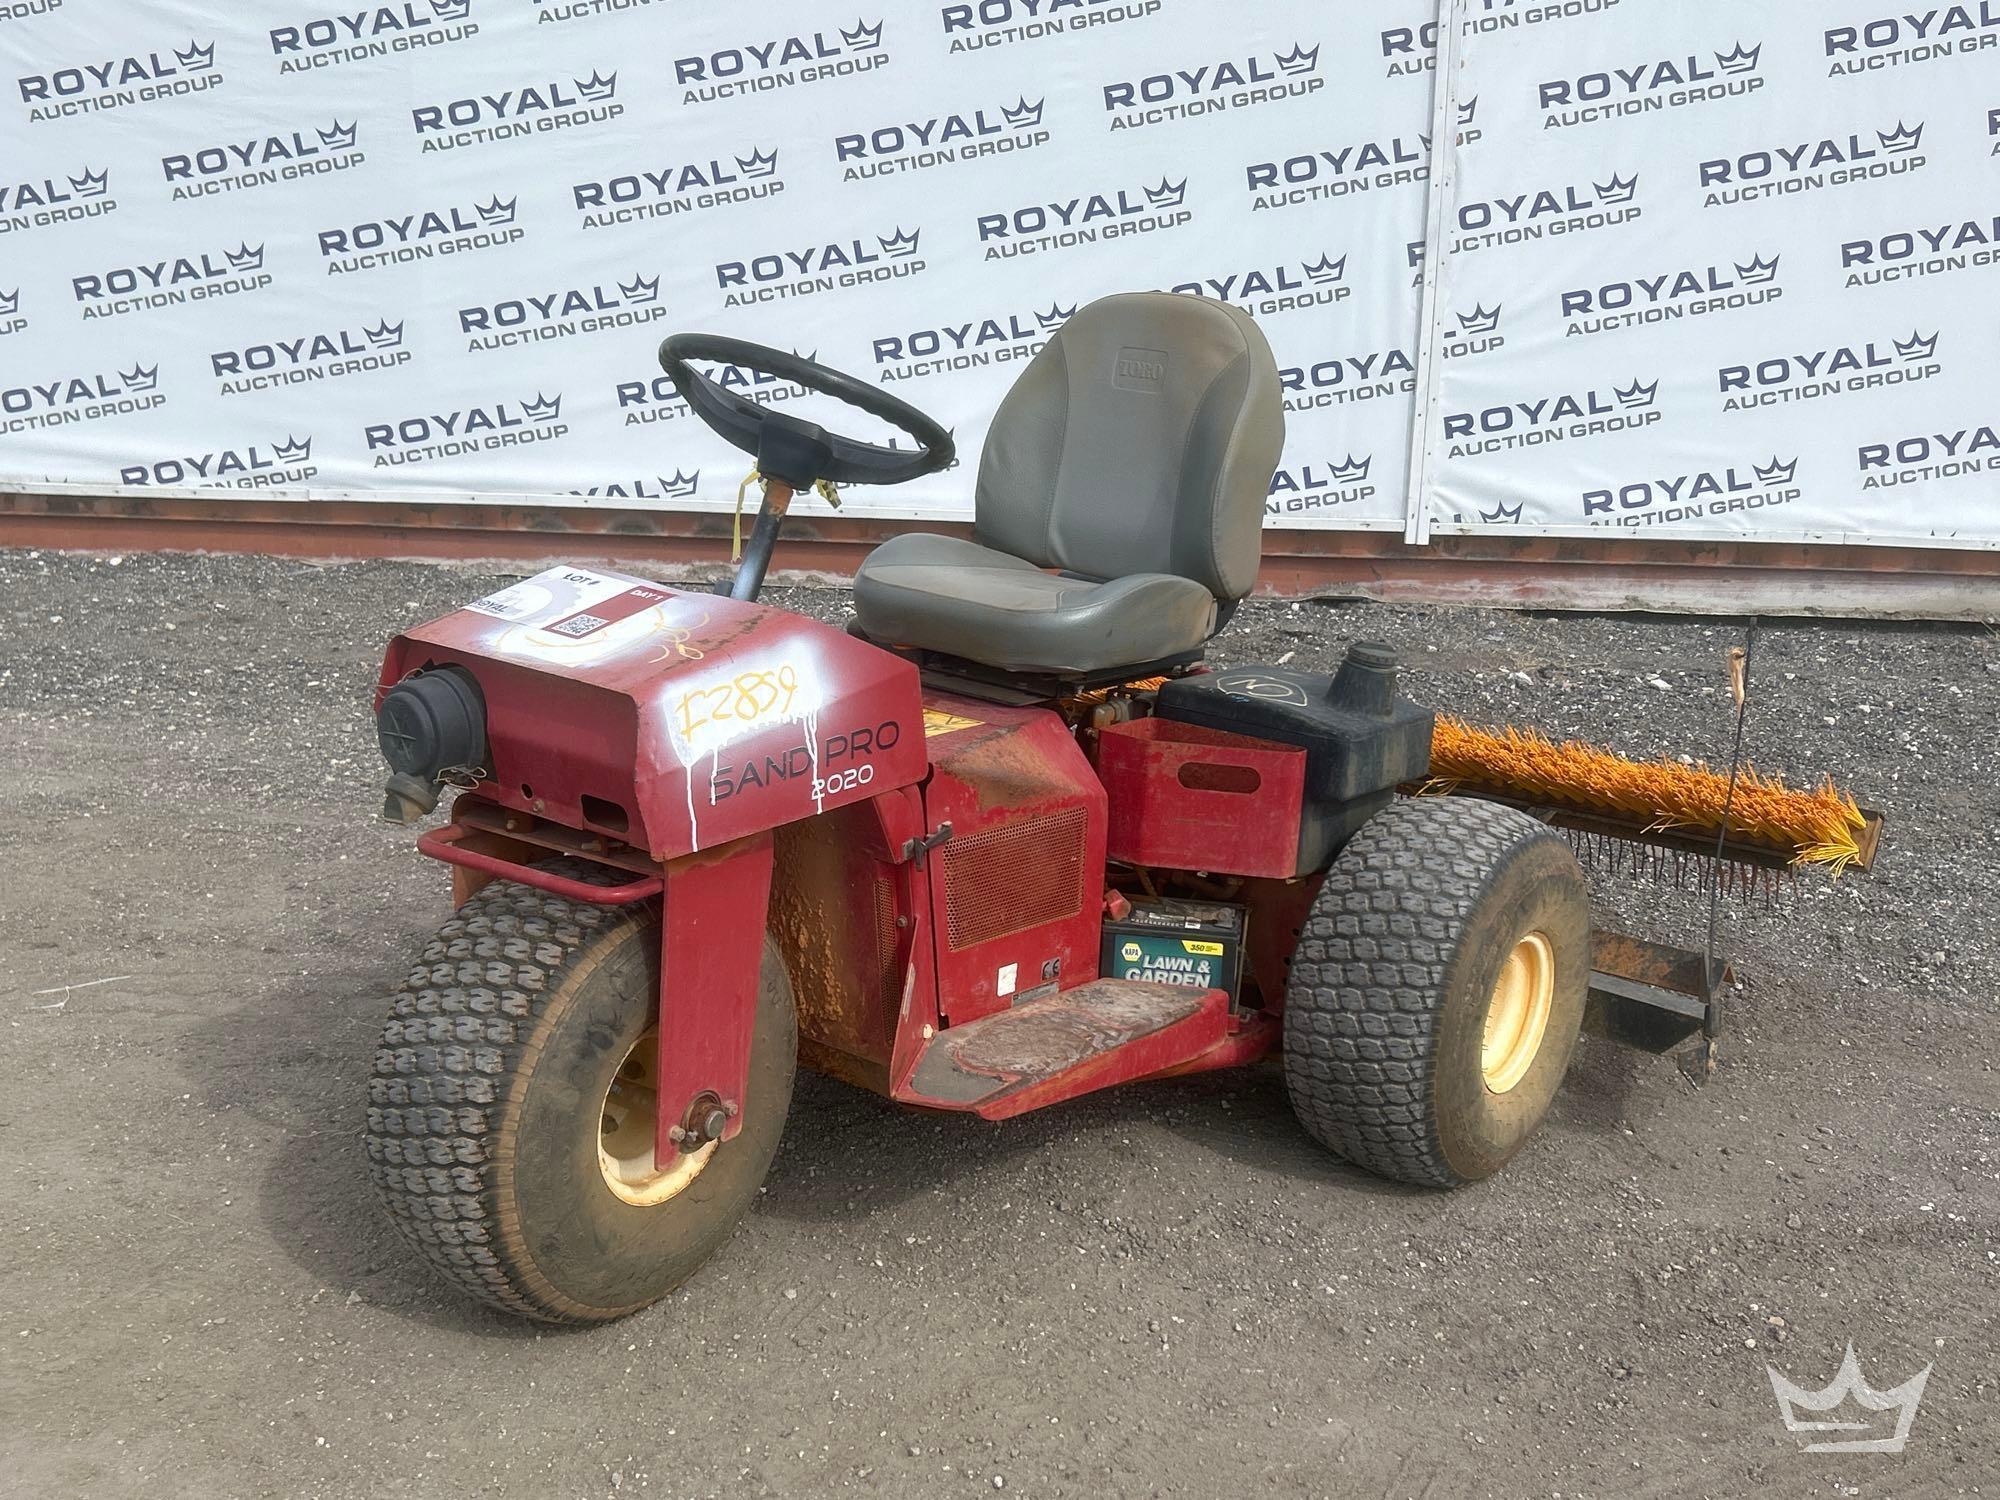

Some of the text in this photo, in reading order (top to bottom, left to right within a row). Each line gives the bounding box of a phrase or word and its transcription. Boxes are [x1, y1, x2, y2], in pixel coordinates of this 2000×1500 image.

[0, 0, 62, 21] ROUP
[270, 3, 431, 54] ROYAL
[950, 0, 1161, 54] AUCTION GROUP
[280, 24, 479, 74] AUCTION GROUP
[674, 33, 841, 85] ROYAL
[1828, 42, 1952, 77] AUCTION
[18, 53, 177, 103] ROYAL
[30, 74, 223, 122] AUCTION GROUP
[683, 54, 889, 105] AUCTION GROUP
[1103, 57, 1275, 111] ROYAL
[1539, 56, 1714, 109] ROYAL
[412, 83, 576, 133] ROYAL
[1110, 78, 1324, 131] AUCTION GROUP
[1544, 77, 1764, 129] AUCTION GROUP
[422, 104, 624, 153] AUCTION GROUP
[835, 110, 1001, 162] ROYAL
[162, 133, 319, 181] ROYAL
[173, 153, 365, 201] AUCTION GROUP
[844, 131, 1049, 182] AUCTION GROUP
[1247, 138, 1419, 191] ROYAL
[1700, 135, 1876, 187] ROYAL
[573, 161, 737, 210] ROYAL
[583, 181, 784, 229] AUCTION GROUP
[1252, 166, 1430, 211] AUCTION GRO
[1704, 156, 1926, 208] AUCTION GROUP
[34, 200, 117, 226] GROUP
[977, 191, 1144, 241] ROYAL
[1450, 207, 1641, 254] UCTION GROUP
[1458, 186, 1592, 230] OYAL
[318, 208, 477, 256] ROYAL
[328, 229, 524, 275] AUCTION GROUP
[985, 211, 1191, 261] AUCTION GROUP
[1841, 216, 2000, 268] ROYA
[72, 254, 227, 301] ROYAL
[716, 240, 879, 288] ROYAL
[725, 261, 926, 308] AUCTION GROUP
[1171, 267, 1302, 301] YAL
[1845, 255, 1965, 288] AUCTION
[83, 274, 272, 320] AUCTION GROUP
[459, 286, 620, 333] ROYAL
[1260, 287, 1350, 314] GROUP
[1561, 267, 1733, 317] ROYAL
[1566, 288, 1782, 337] AUCTION GROUP
[469, 307, 666, 352] AUCTION GROUP
[873, 315, 1035, 363] ROYAL
[1443, 337, 1504, 359] OUP
[211, 331, 366, 377] ROYAL
[221, 351, 411, 395] AUCTION GROUP
[880, 342, 1045, 382] AUCTION GRO
[1279, 350, 1413, 393] ROYA
[1719, 343, 1892, 392] ROYAL
[2, 375, 121, 413] OYAL
[85, 395, 166, 419] GROUP
[616, 364, 777, 407] ROAL
[1283, 382, 1394, 411] AUCTION
[1723, 364, 1941, 412] AUCTION GROUP
[365, 405, 522, 449] ROYAL
[1443, 391, 1613, 440] ROYAL
[1448, 411, 1661, 459] AUCTION GROUP
[120, 447, 273, 486] ROYAL
[374, 425, 568, 468] AUCTION GROUP
[1859, 427, 2000, 470] ROYA
[237, 467, 317, 488] GROUP
[1583, 469, 1752, 516] ROYAL
[1863, 459, 1980, 490] AUCTION
[1287, 486, 1375, 512] GROUP
[1709, 489, 1800, 514] GROUP
[629, 590, 658, 600] DAY
[709, 721, 899, 803] SAND PRO
[812, 764, 873, 800] 2020
[1143, 955, 1211, 974] LAWN &
[1190, 944, 1205, 952] 350
[1125, 967, 1212, 989] GARDEN
